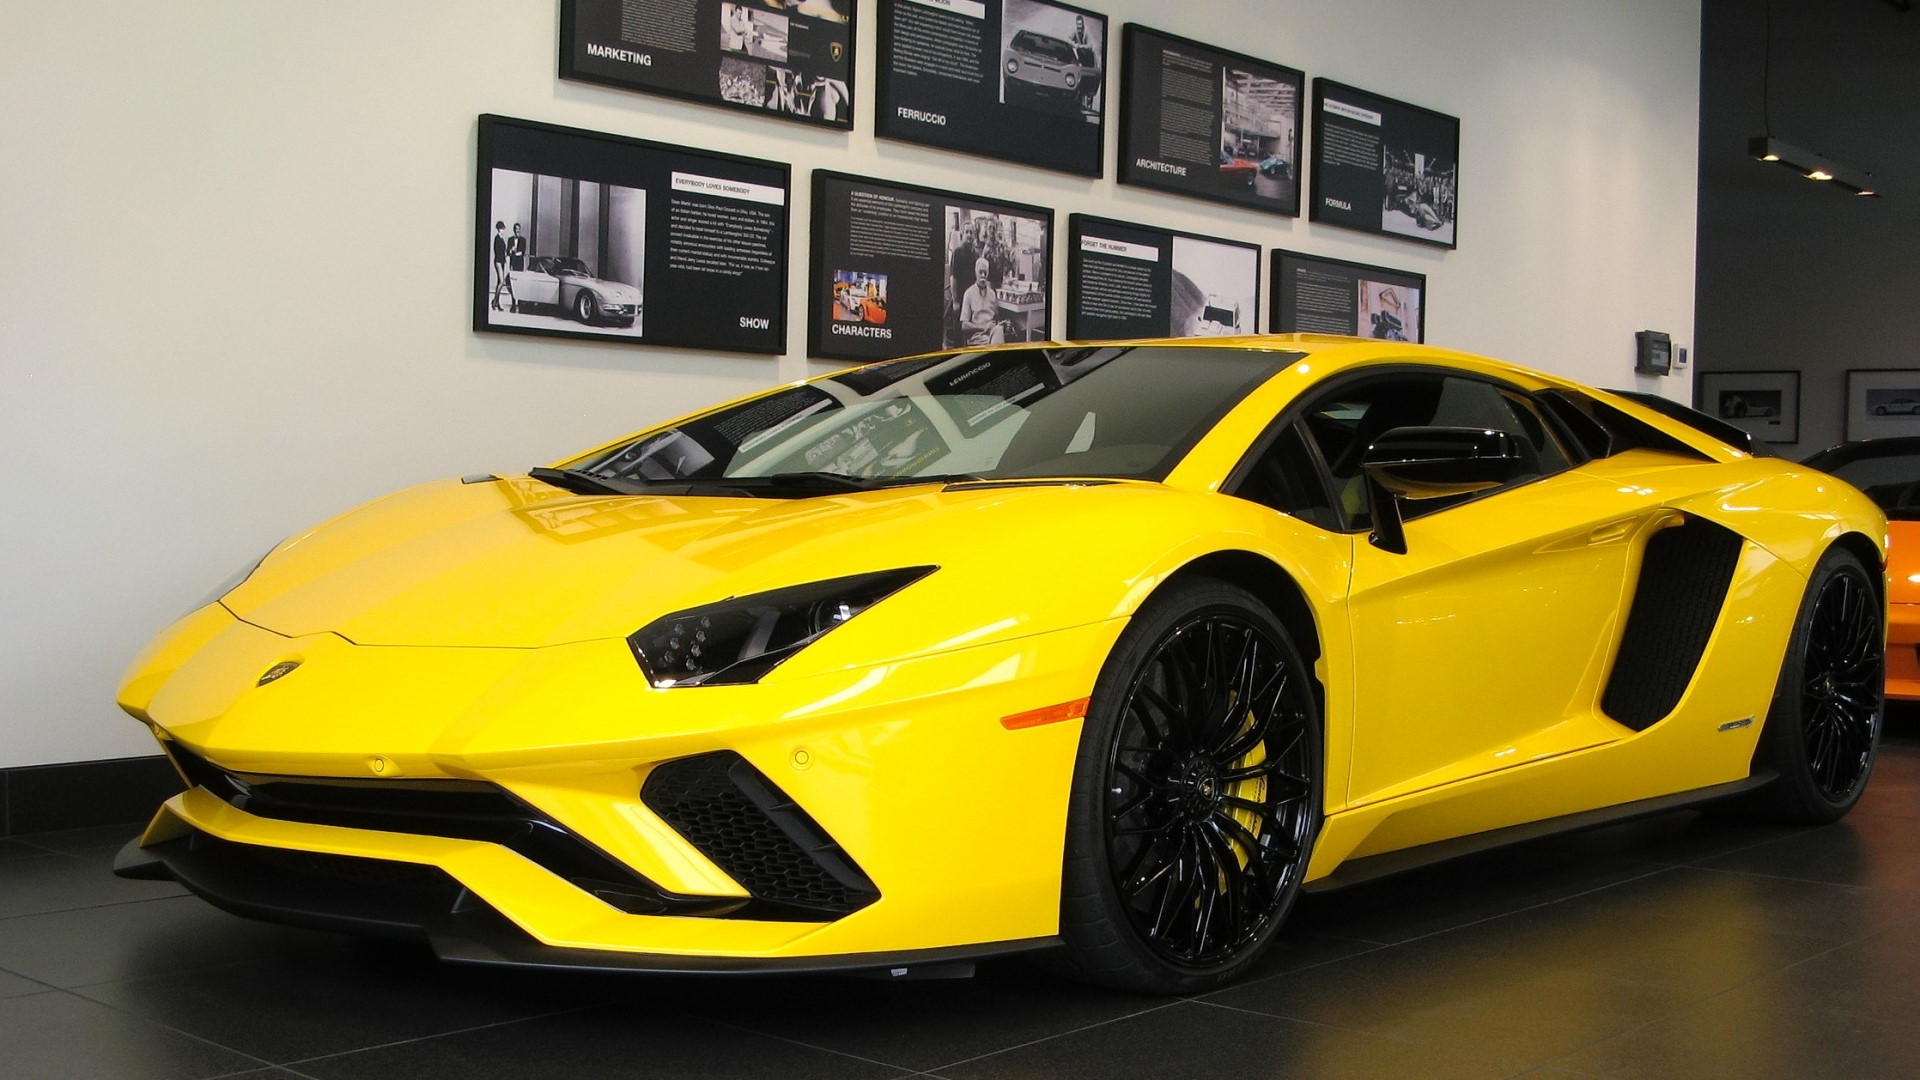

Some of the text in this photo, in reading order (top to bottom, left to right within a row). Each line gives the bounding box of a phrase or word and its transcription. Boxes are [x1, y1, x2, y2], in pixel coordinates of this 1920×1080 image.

[587, 43, 652, 67] MARKETING
[897, 107, 947, 126] FERRUCCIO
[1136, 157, 1188, 177] ARCHITECTURE
[675, 178, 750, 195] EVERYBODY LOVES SOMEBODY
[1325, 197, 1352, 212] FORMULA
[1081, 239, 1098, 248] FORGET
[739, 316, 770, 331] SHOW
[831, 322, 892, 340] CHARACTERS
